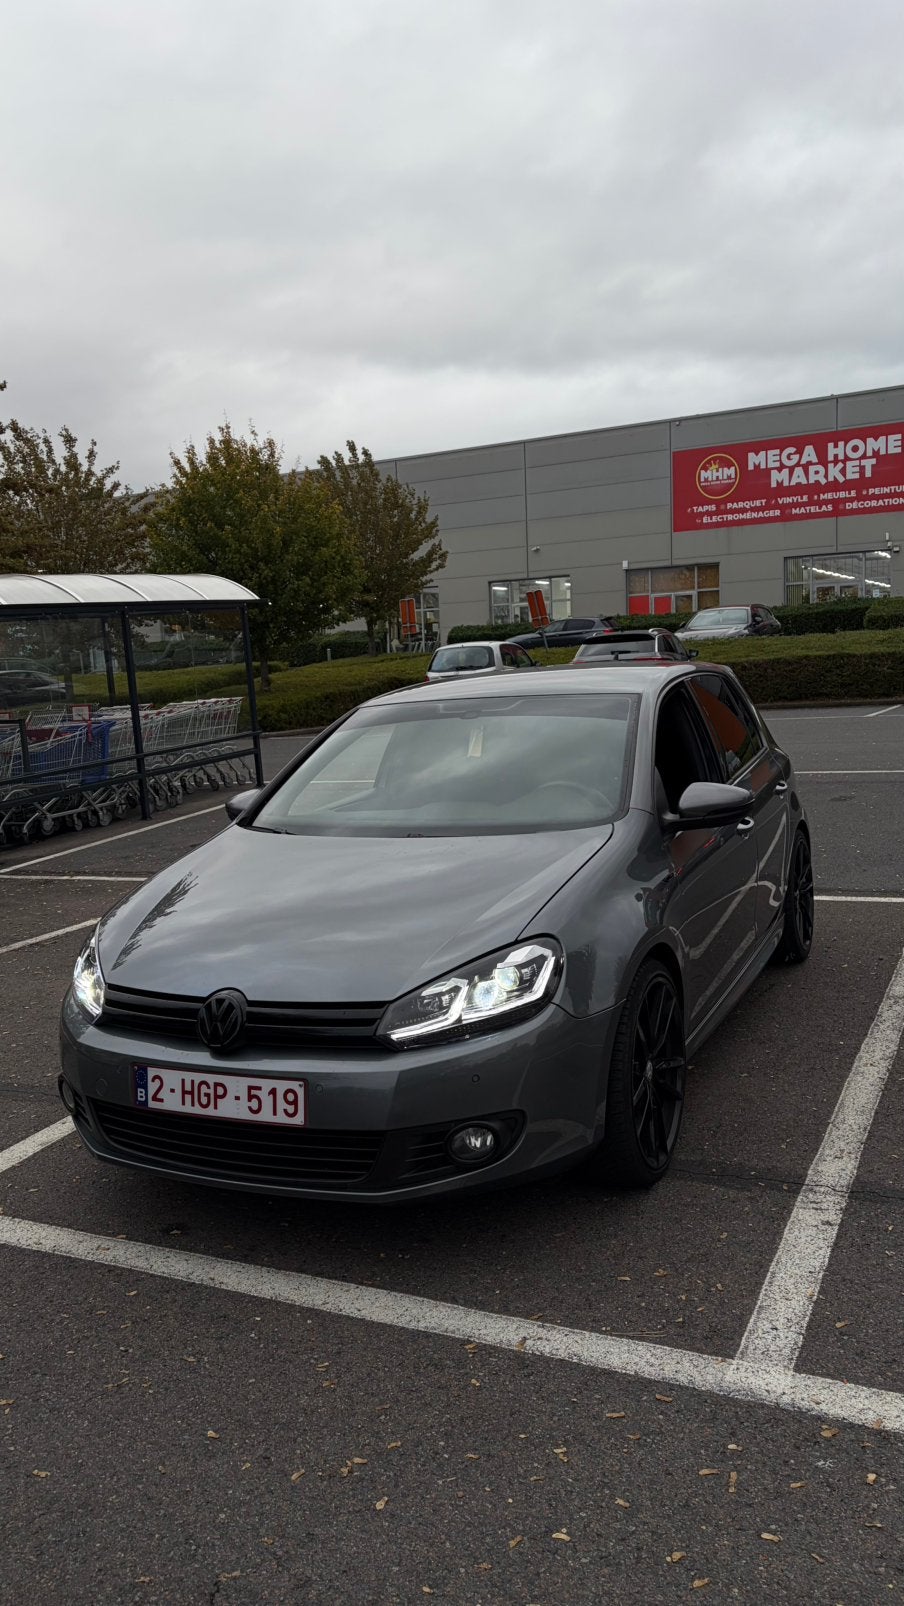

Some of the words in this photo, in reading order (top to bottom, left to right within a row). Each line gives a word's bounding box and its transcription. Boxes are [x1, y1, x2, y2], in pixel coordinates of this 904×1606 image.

[747, 445, 818, 471] MEGA
[827, 433, 902, 461] HOME
[700, 466, 736, 482] MHM
[771, 457, 877, 488] MARKET
[692, 504, 717, 513] TAPIS
[726, 499, 767, 510] PARQUET
[777, 494, 809, 505] VINYLE
[819, 489, 857, 500] MEUBLE
[868, 485, 904, 496] PEINTU
[702, 509, 781, 524] ÉLECTROMÉNAGER
[791, 504, 833, 515] MATELAS
[137, 1088, 146, 1102] B
[150, 1074, 299, 1119] 2-HGP-519
